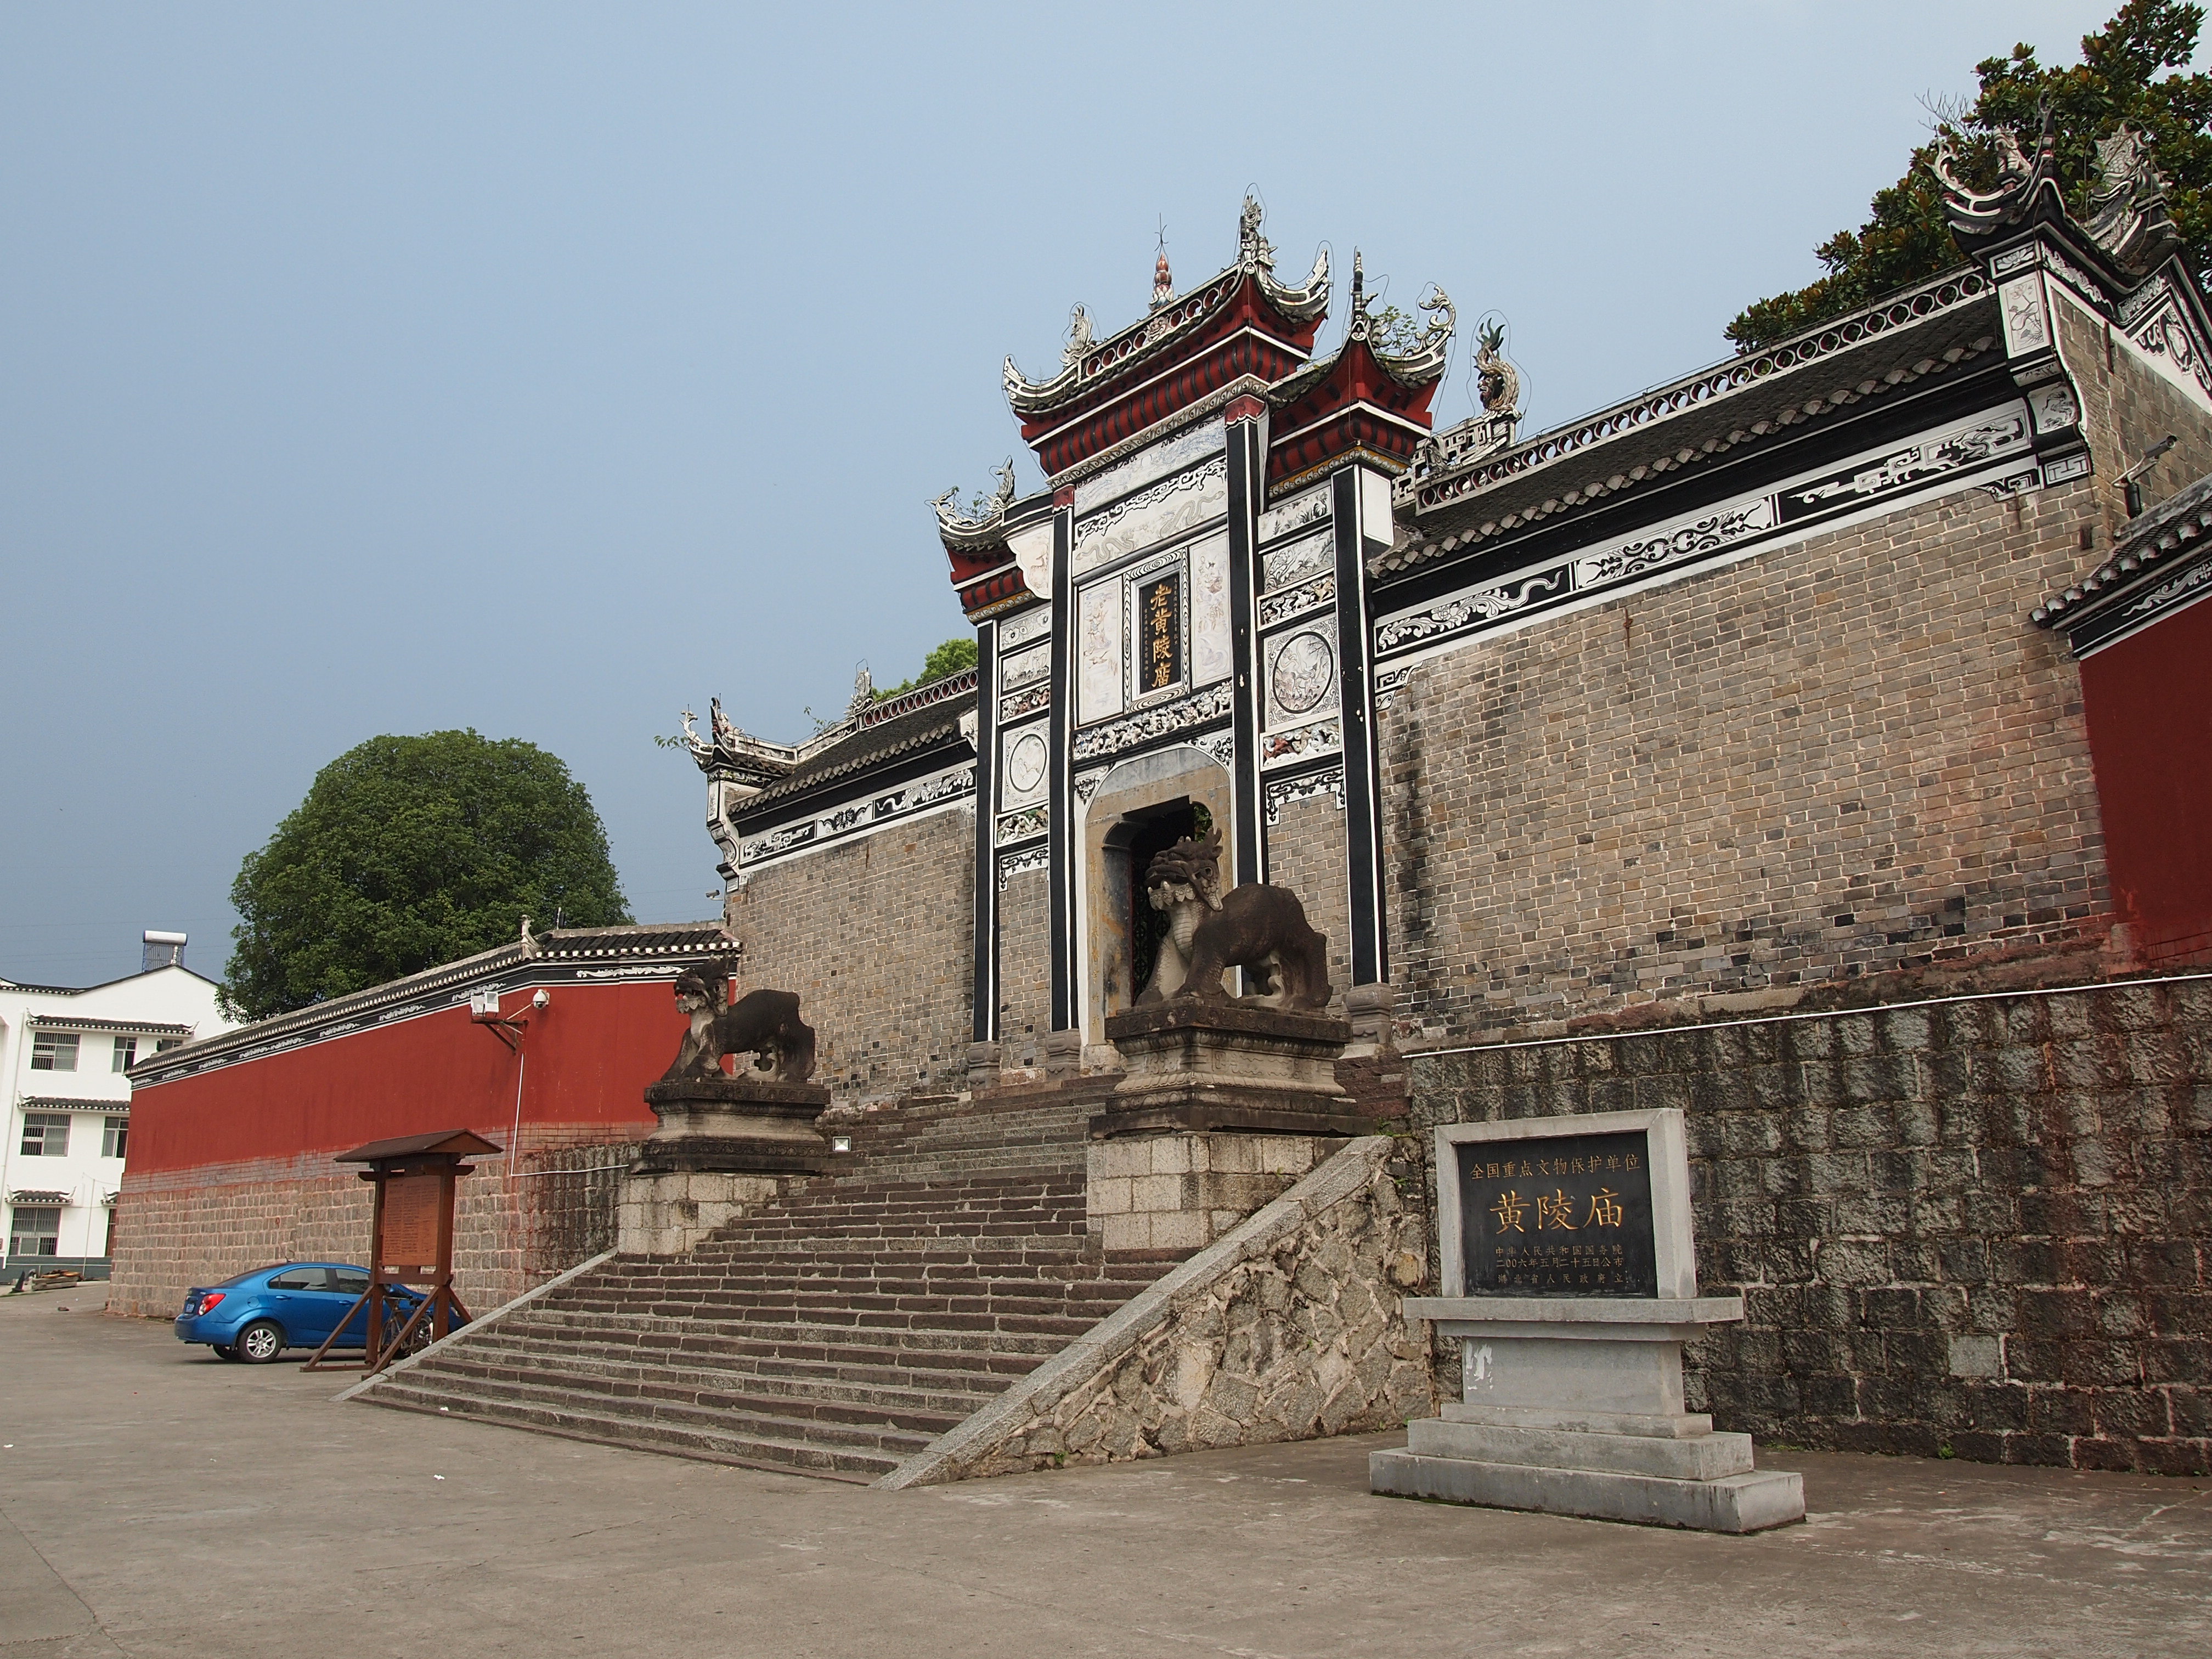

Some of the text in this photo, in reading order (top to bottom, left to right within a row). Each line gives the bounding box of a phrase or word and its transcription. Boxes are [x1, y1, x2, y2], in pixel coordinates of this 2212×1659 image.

[1469, 1153, 1641, 1180] 全国重点文物保护单位
[1489, 1187, 1623, 1234] 黄陵庙
[1496, 1244, 1623, 1257] 中华人民共和国国务院
[1498, 1274, 1624, 1284] 湖北省人民政府立
